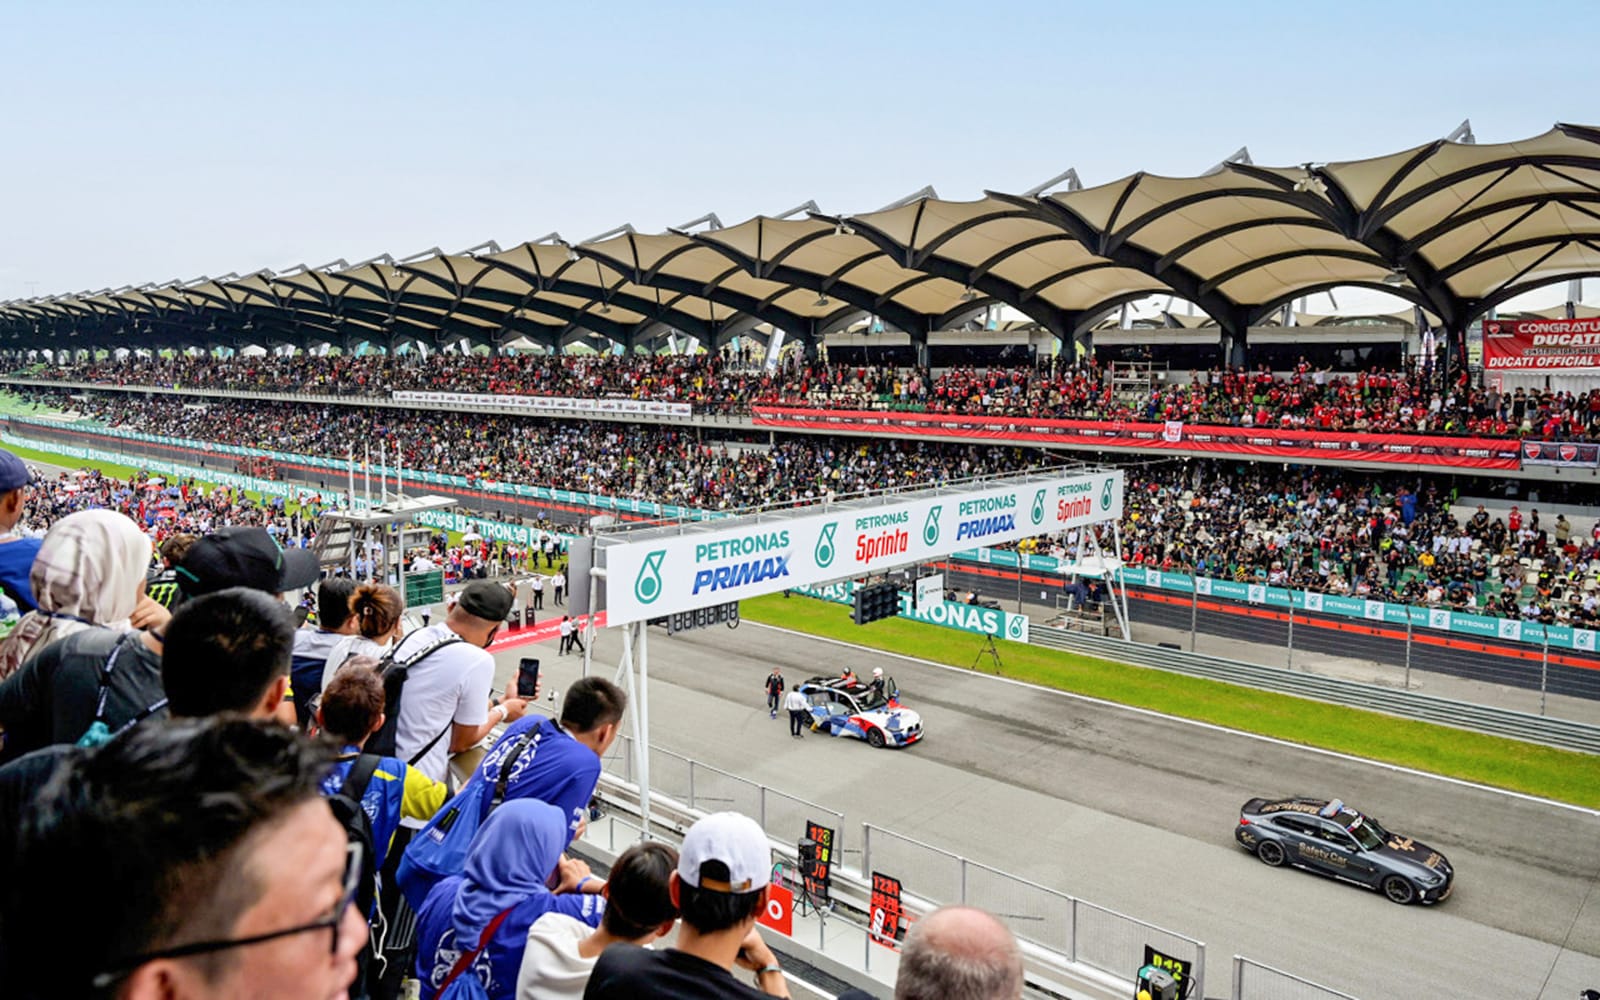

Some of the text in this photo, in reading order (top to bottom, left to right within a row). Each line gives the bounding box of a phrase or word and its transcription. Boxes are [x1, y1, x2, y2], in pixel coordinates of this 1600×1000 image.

[1489, 355, 1595, 367] DUCATI OFFICIAL
[1057, 482, 1092, 496] PETRONAS
[959, 494, 1016, 516] PETRONAS
[1057, 496, 1091, 523] Sprinta
[855, 511, 909, 530] PETRONAS
[956, 513, 1016, 541] PRIMAX
[696, 530, 790, 563] PETRONAS
[855, 528, 909, 564] Sprinta
[692, 553, 791, 595] PRIMAX
[898, 593, 999, 634] TRONAS
[1299, 842, 1329, 860] Safety
[1330, 852, 1348, 865] Car
